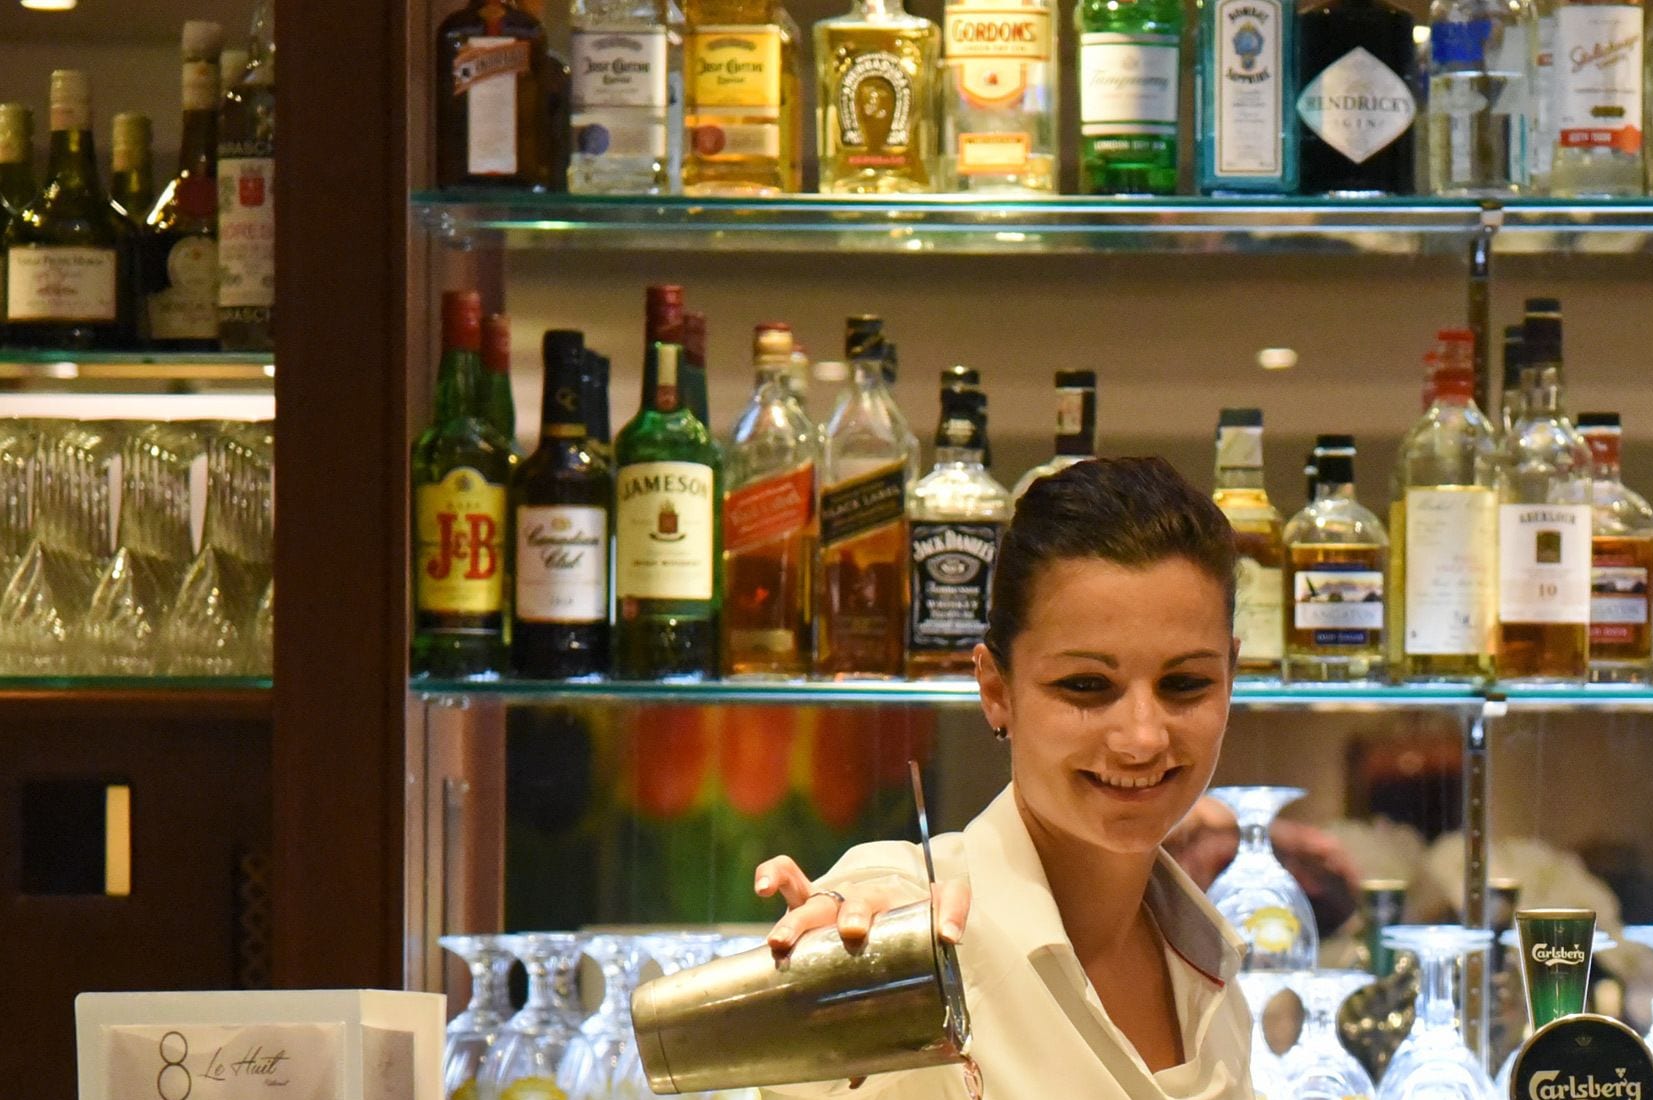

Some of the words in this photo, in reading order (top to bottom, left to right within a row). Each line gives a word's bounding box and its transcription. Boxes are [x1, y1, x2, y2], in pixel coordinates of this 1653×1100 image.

[1343, 118, 1377, 127] GIN
[622, 474, 707, 502] JAMESON
[1532, 943, 1585, 966] Carlsberg
[197, 1047, 226, 1081] Le
[230, 1046, 290, 1077] Huit
